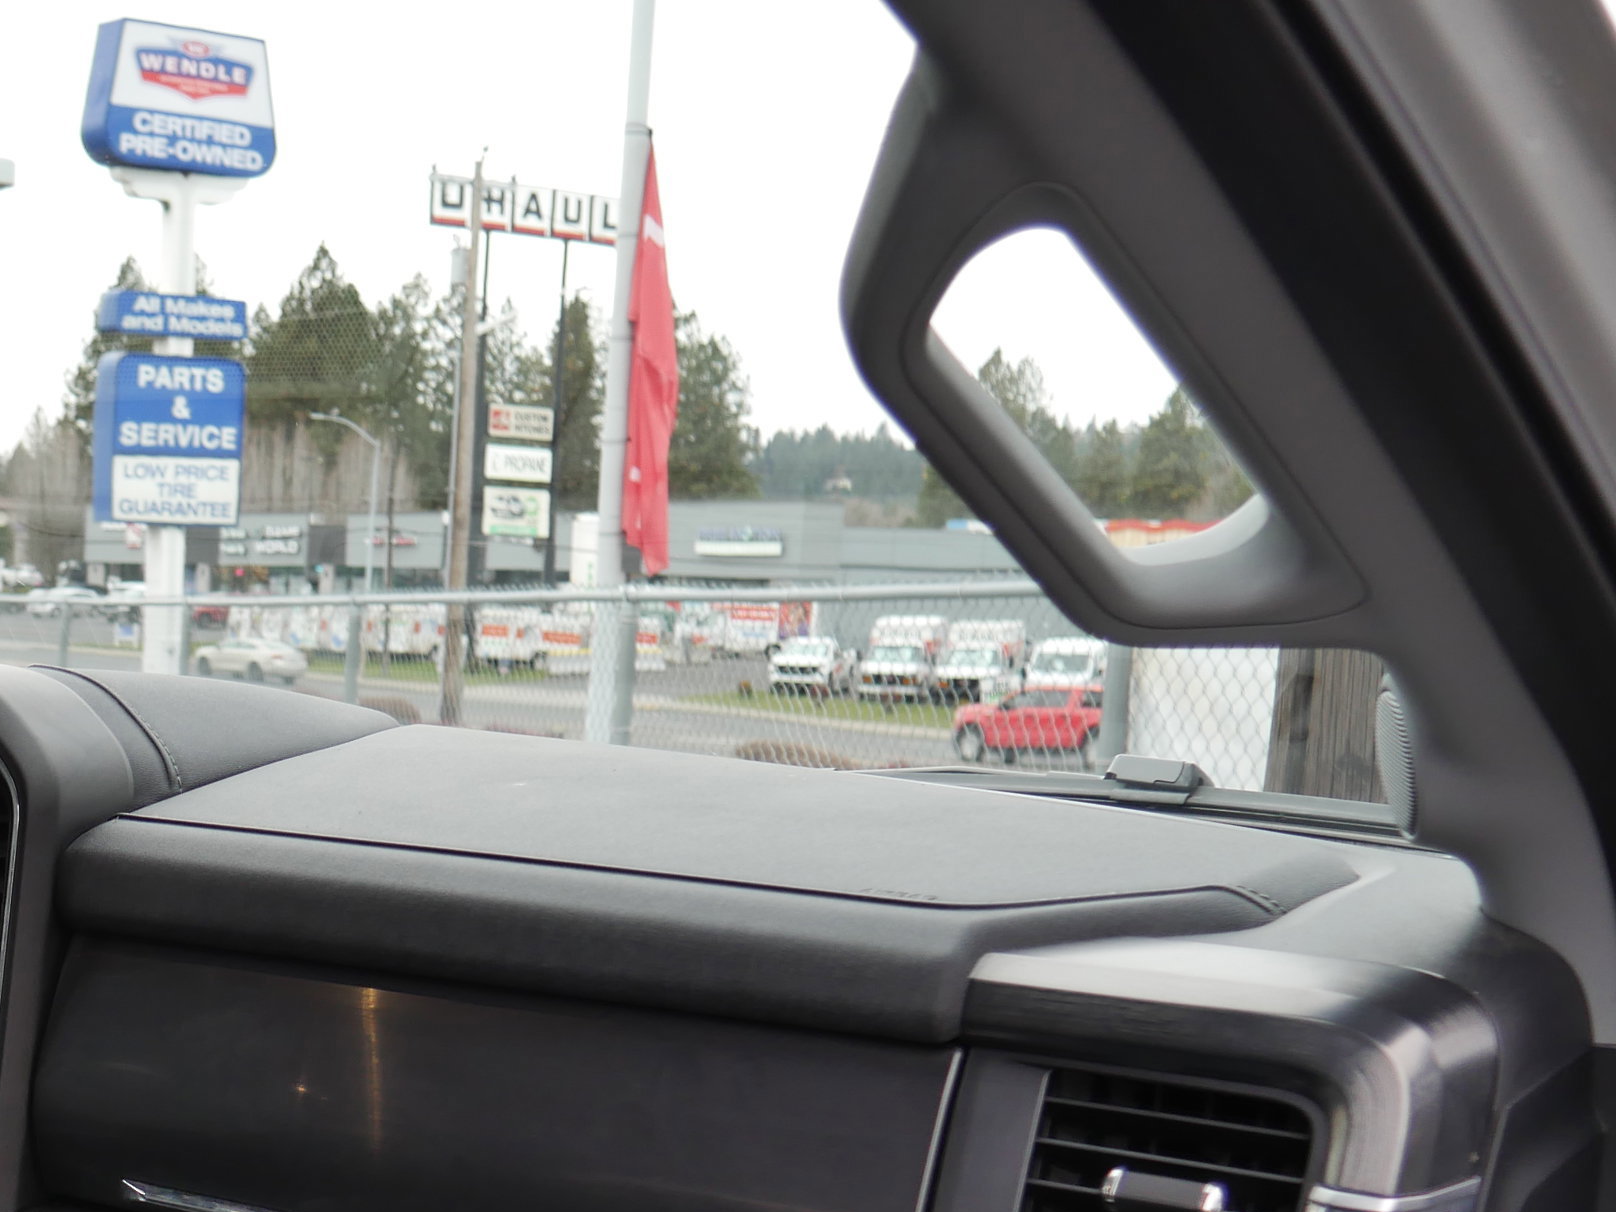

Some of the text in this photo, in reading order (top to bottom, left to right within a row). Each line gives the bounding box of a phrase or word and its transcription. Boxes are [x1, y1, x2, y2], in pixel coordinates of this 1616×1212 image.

[139, 51, 247, 86] WENDLE
[133, 110, 252, 147] CERTIFIED
[119, 131, 264, 172] PRE-OWNED
[134, 296, 234, 320] All Makes
[122, 314, 243, 338] and Models
[137, 365, 224, 393] PARTS
[171, 396, 191, 419] &
[119, 422, 238, 450] SERVICE
[124, 463, 229, 481] LOW PRICE
[157, 483, 196, 499] TIRE
[120, 500, 230, 518] GUARANTEE
